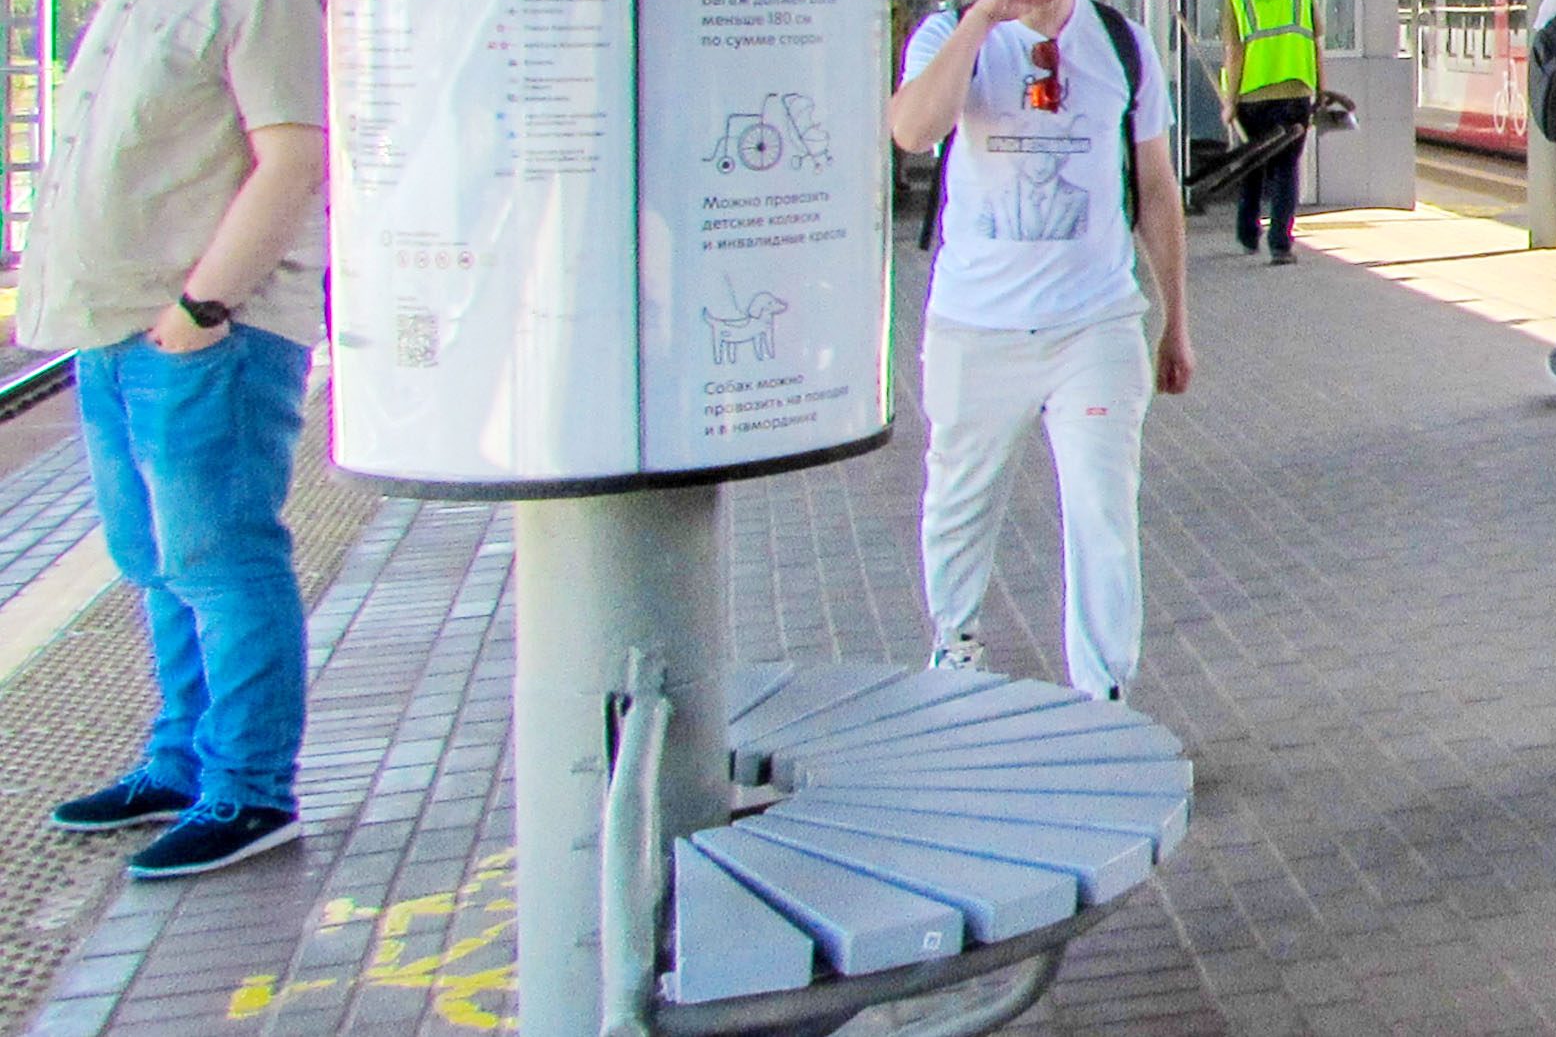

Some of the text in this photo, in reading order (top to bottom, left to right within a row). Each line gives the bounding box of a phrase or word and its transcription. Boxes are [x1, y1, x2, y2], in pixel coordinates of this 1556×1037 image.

[701, 15, 765, 26] меньше
[767, 12, 792, 26] 180
[701, 35, 722, 47] по
[725, 35, 777, 50] сумме
[702, 196, 762, 210] Можно
[702, 217, 765, 232] детские
[702, 241, 713, 251] и
[717, 233, 806, 250] инвалидные
[704, 374, 805, 396] Собак можно
[704, 399, 784, 417] провозить
[704, 426, 715, 436] и
